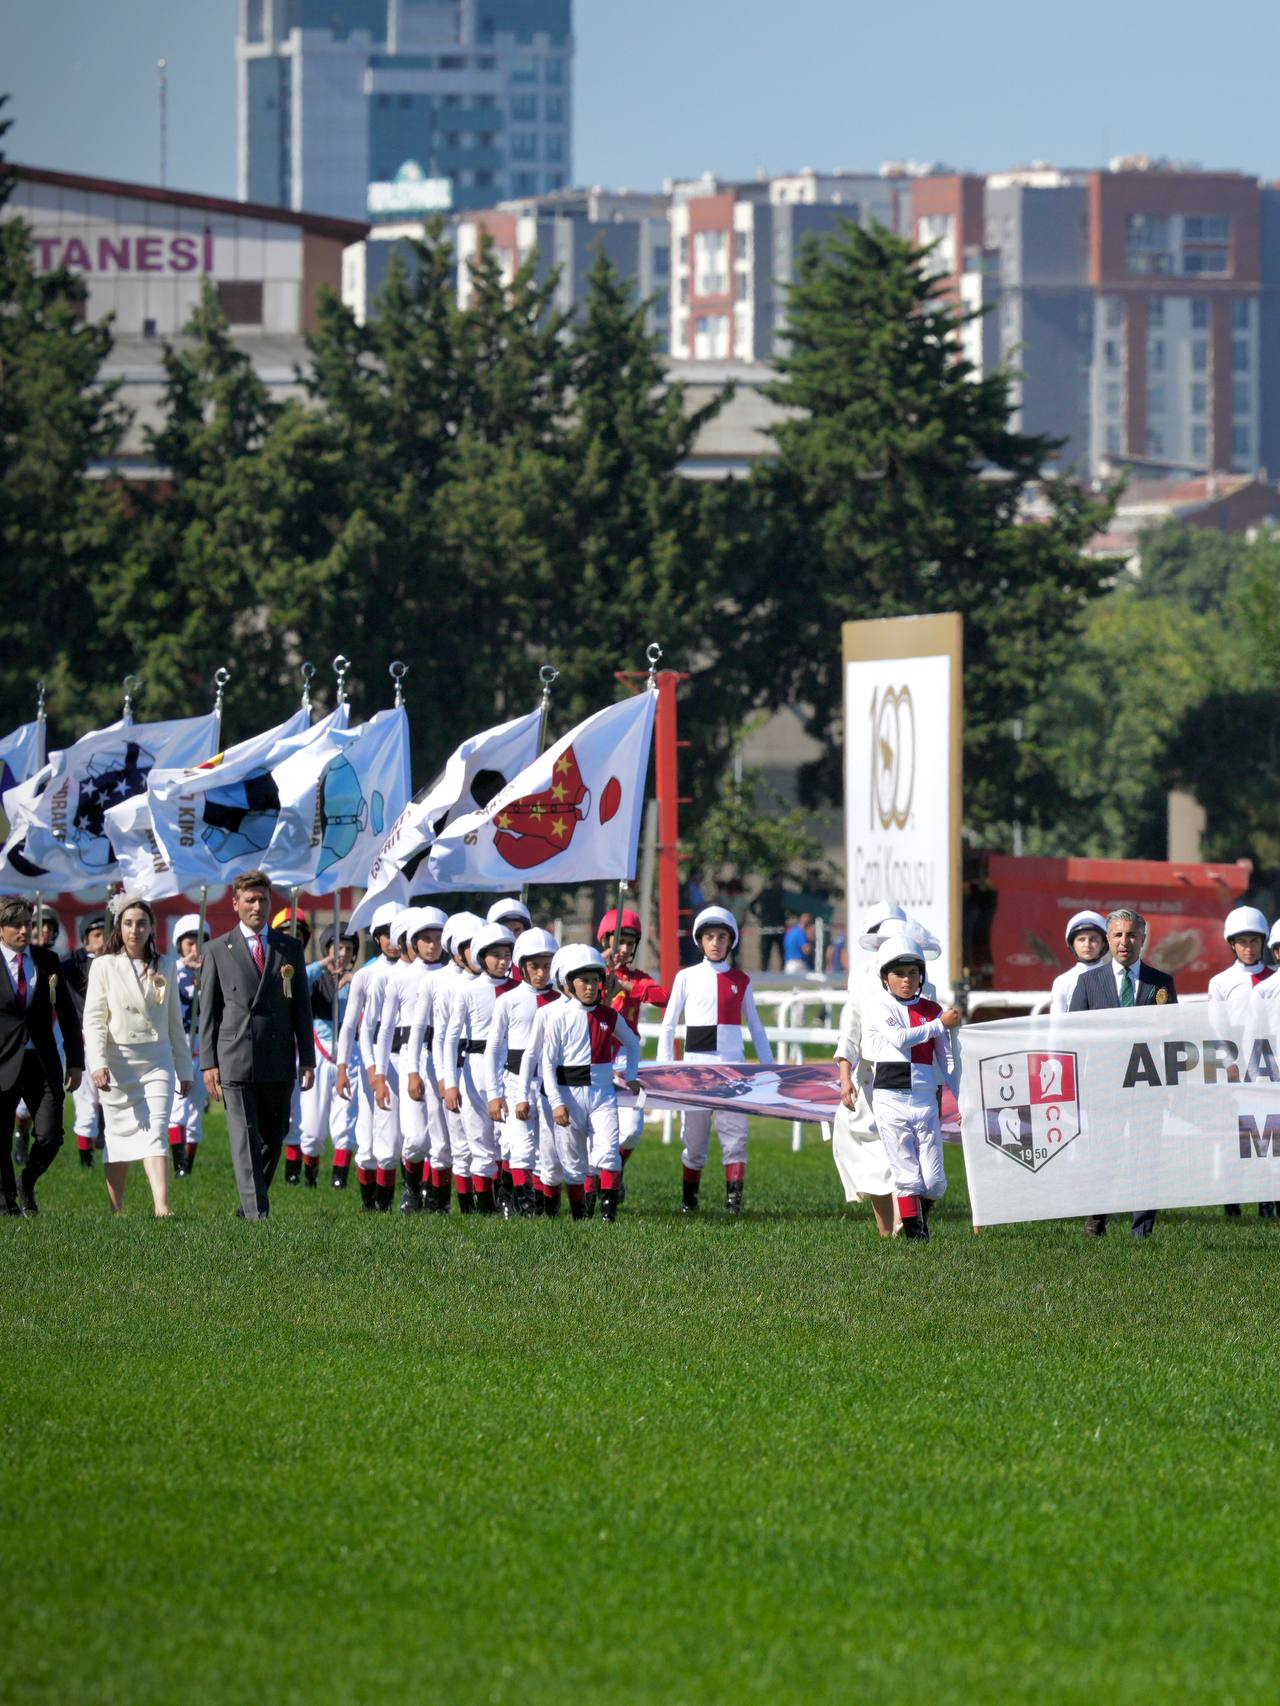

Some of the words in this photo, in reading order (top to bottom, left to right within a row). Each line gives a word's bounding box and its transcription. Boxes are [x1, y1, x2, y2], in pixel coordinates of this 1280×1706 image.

[33, 227, 214, 272] TANESİ
[179, 807, 196, 848] KING
[1019, 1147, 1048, 1161] 1950
